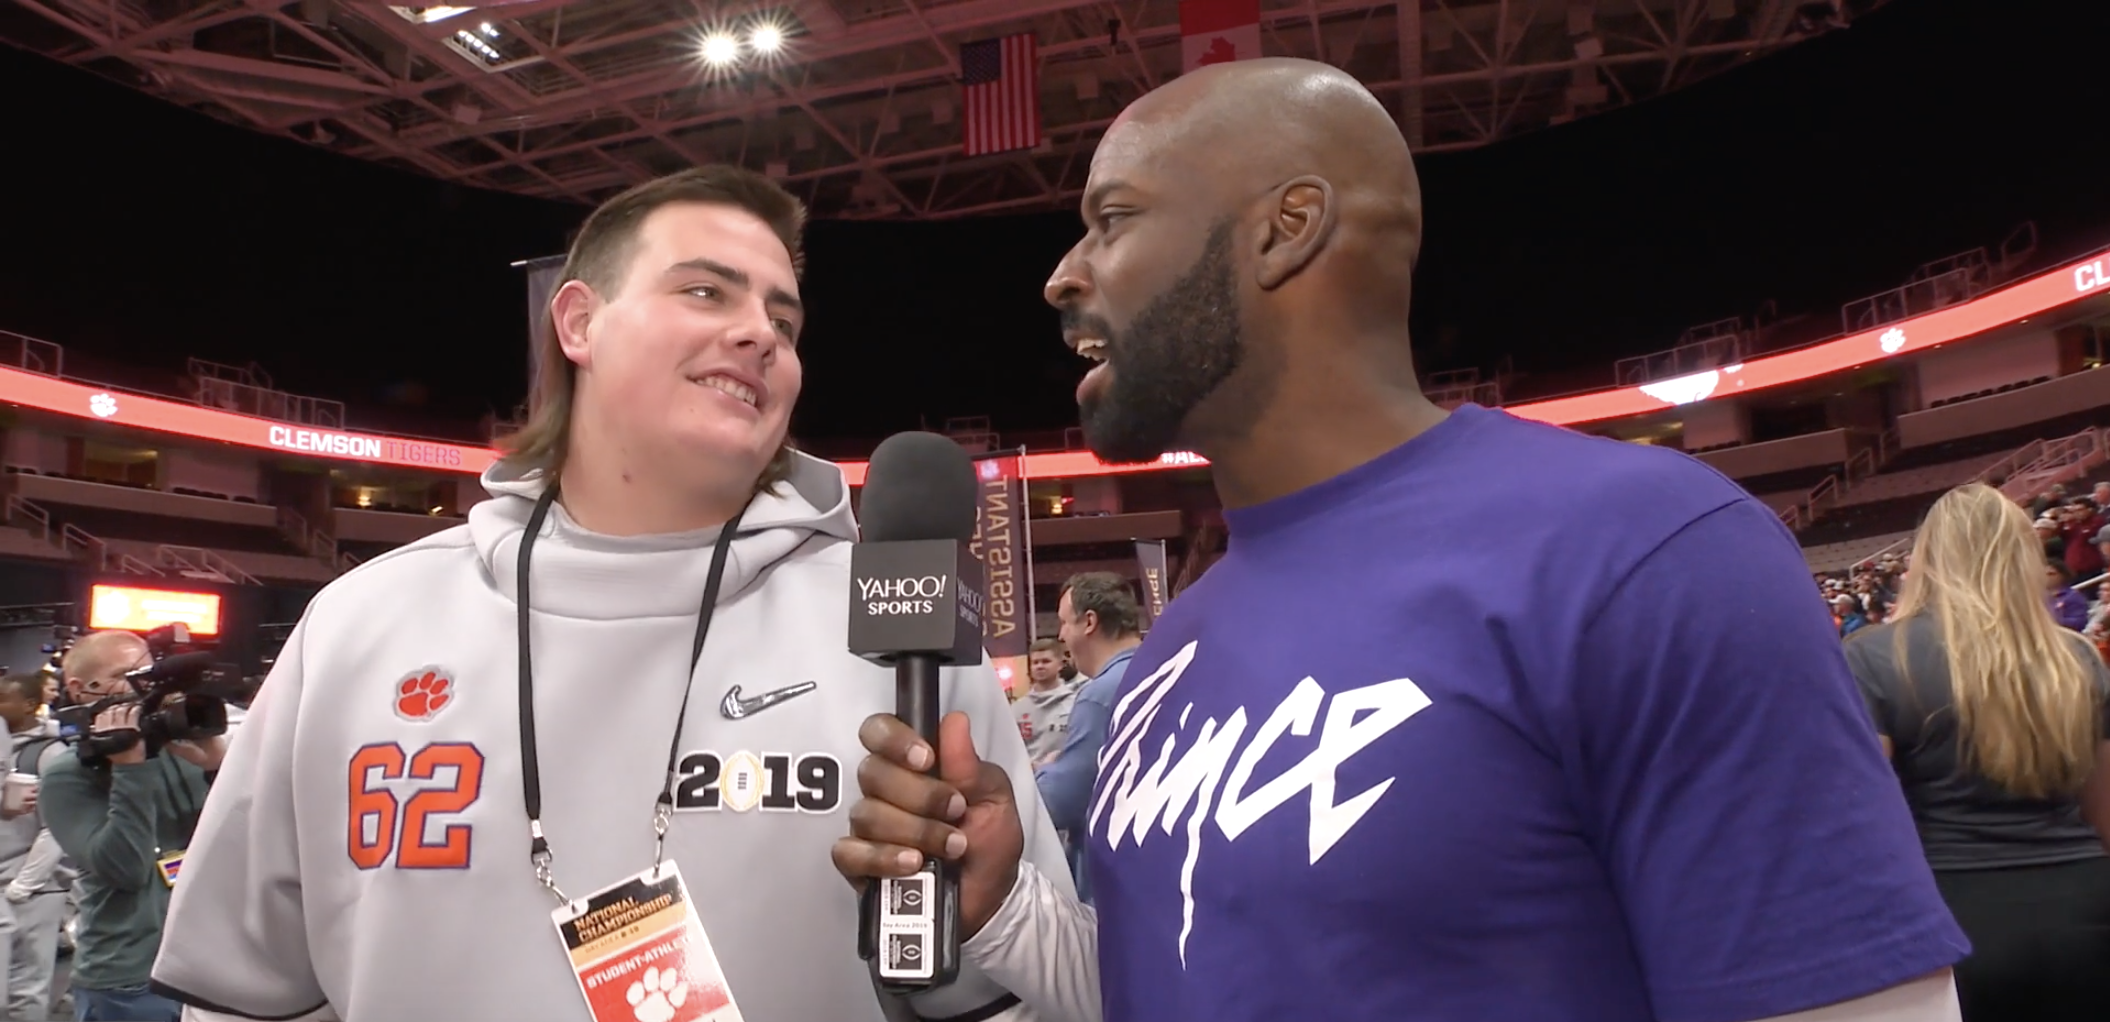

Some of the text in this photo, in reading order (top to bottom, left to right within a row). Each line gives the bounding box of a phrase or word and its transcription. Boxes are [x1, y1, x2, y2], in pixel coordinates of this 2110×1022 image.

[2074, 260, 2110, 292] CL
[269, 425, 461, 467] CLEMSON TIGERS
[857, 574, 947, 601] YAHOO!
[867, 600, 934, 616] SPORTS
[347, 740, 485, 871] 62
[1088, 639, 1433, 971] Prince
[574, 896, 638, 930] NATIONAL
[578, 893, 673, 943] CHAMPIONSHIP
[586, 935, 689, 989] STUDENT-ATHLE
